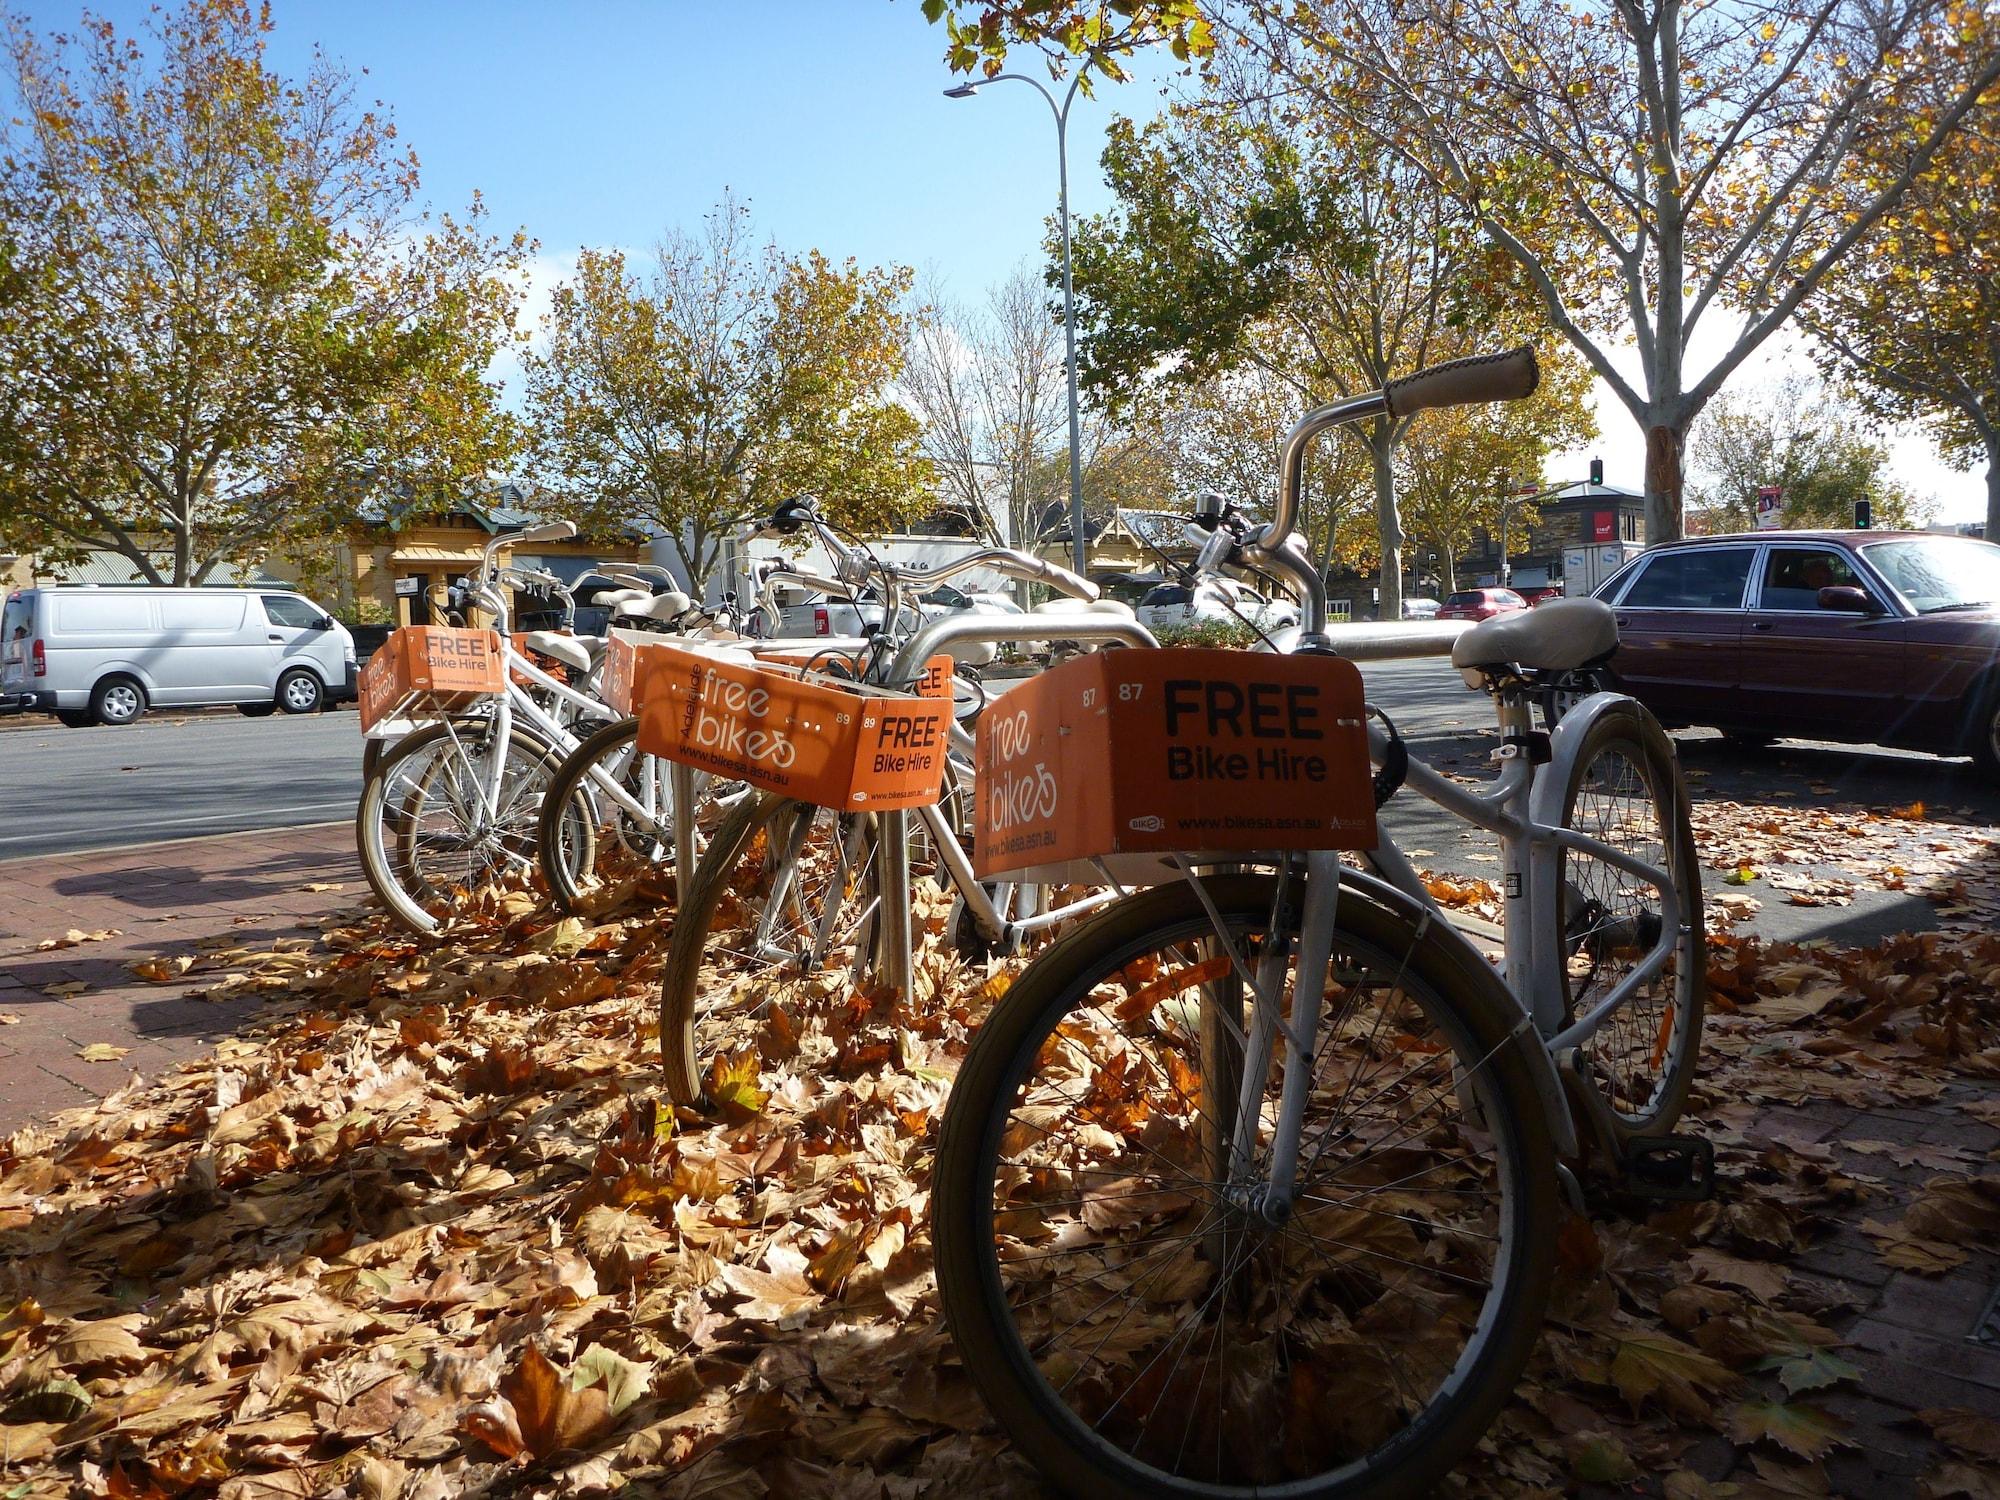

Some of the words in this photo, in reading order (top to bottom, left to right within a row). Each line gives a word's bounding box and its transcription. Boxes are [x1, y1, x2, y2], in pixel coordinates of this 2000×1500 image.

[426, 635, 486, 657] FREE
[368, 657, 386, 686] free
[428, 656, 457, 669] Bike
[459, 658, 487, 671] Hire
[680, 663, 702, 739] Adelaide
[702, 667, 770, 718] free
[1082, 688, 1096, 707] 87
[1118, 683, 1143, 700] 87
[836, 713, 850, 725] 89
[863, 717, 876, 728] 89
[1163, 679, 1325, 741] FREE
[696, 707, 796, 768] bikes
[877, 716, 939, 749] FREE
[991, 710, 1031, 769] free
[679, 745, 790, 787] www.bikesa.asn.au
[873, 754, 906, 773] Bike
[907, 753, 932, 771] Hire
[1167, 746, 1249, 782] Bike
[1257, 747, 1328, 783] Hire
[991, 762, 1057, 832] bikes
[1177, 815, 1322, 831] www.bikesa.asn.au
